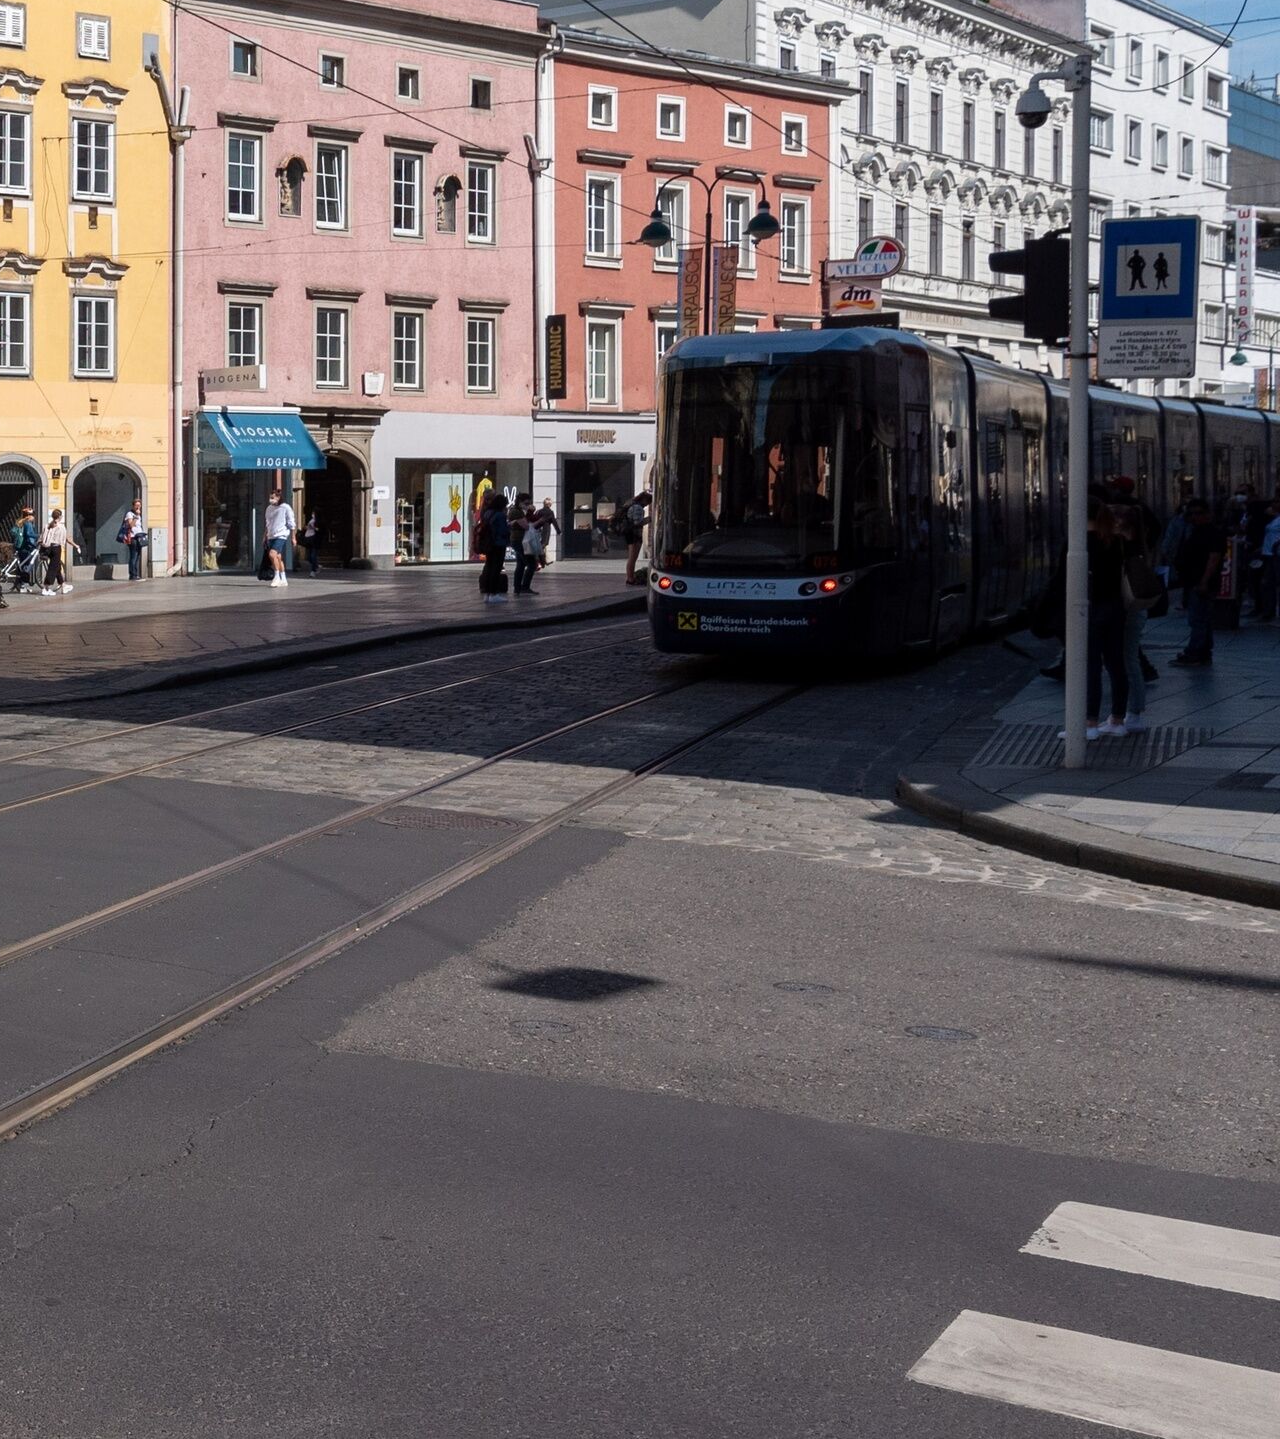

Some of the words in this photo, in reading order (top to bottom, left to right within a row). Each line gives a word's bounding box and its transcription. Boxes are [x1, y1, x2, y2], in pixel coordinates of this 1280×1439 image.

[1237, 208, 1251, 297] WINKLER
[841, 286, 871, 301] dm
[550, 325, 561, 389] HUMANIC
[207, 373, 257, 384] BIOGENA
[232, 427, 292, 437] BIOGENA
[576, 429, 616, 444] HUMANIC
[256, 458, 302, 467] BIOGENA
[750, 582, 777, 590] AG
[700, 615, 746, 625] Raiffeisen
[749, 617, 809, 626] Landesbank
[700, 624, 771, 634] Oberösterreich
